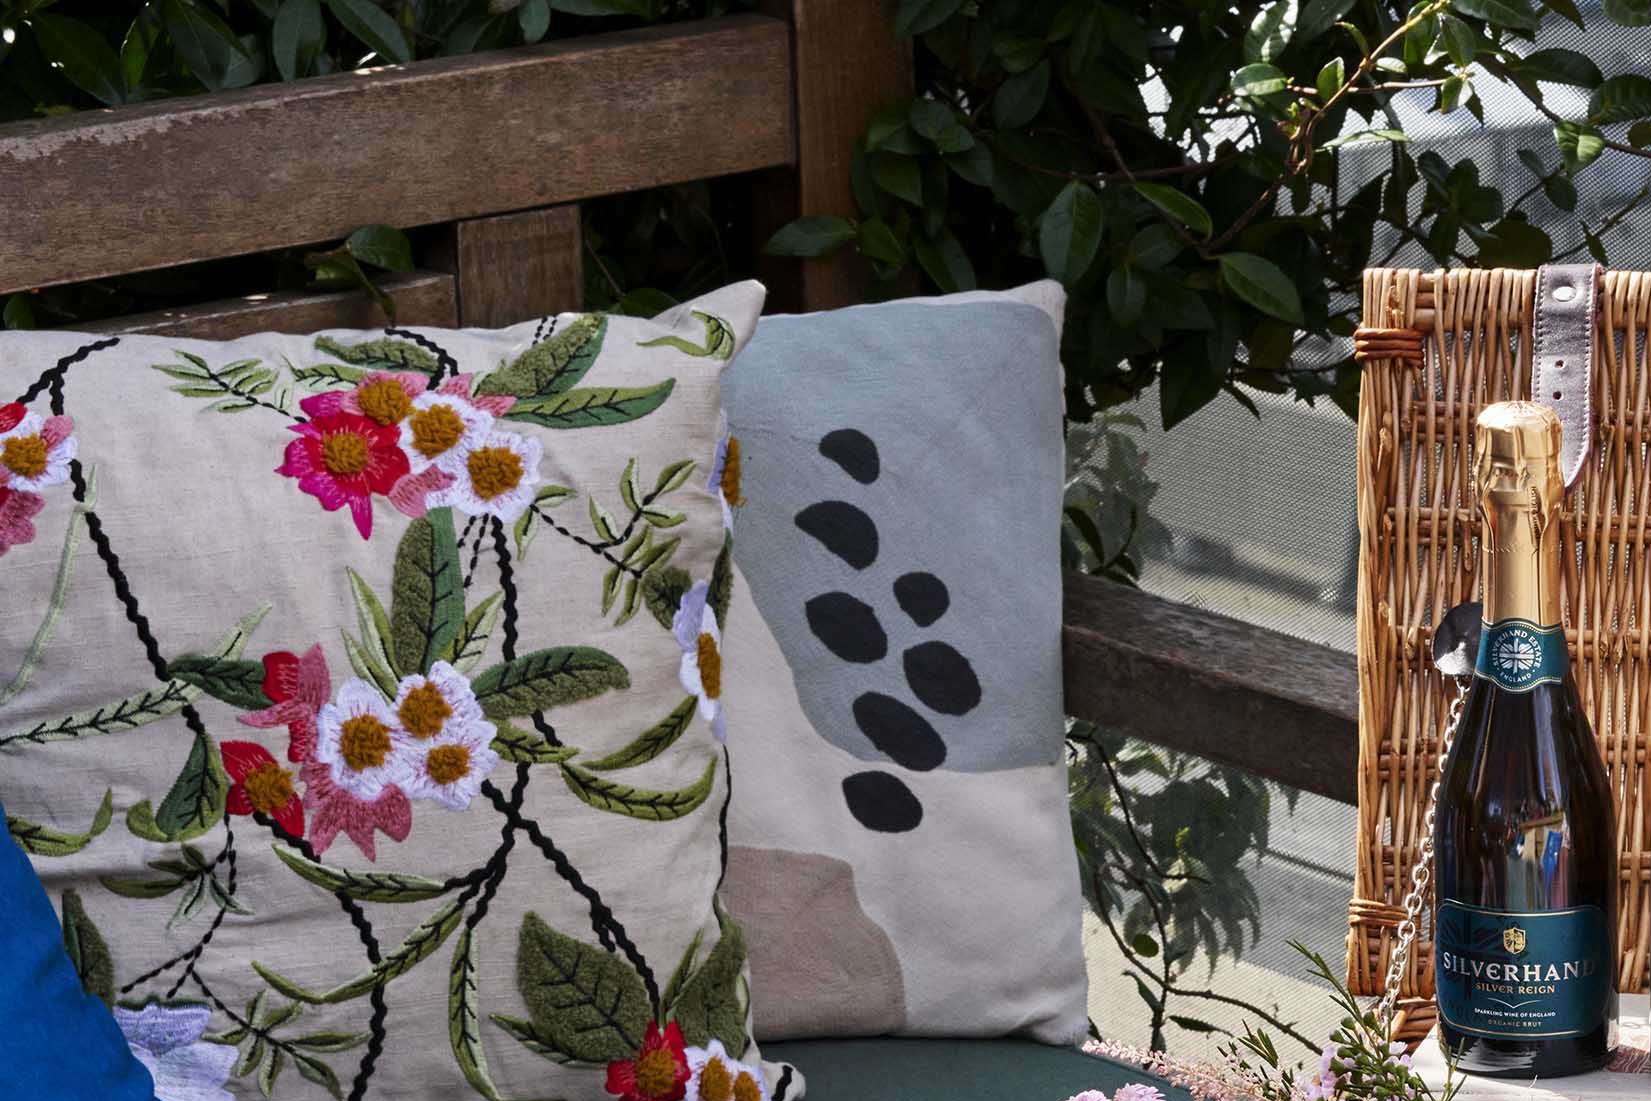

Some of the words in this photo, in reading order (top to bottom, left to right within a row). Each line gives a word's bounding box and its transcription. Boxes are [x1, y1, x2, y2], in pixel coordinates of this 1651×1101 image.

[1528, 636, 1542, 668] ESTATE
[1443, 951, 1596, 983] SILVERHAND
[1475, 982, 1514, 995] SILVER
[1518, 984, 1556, 995] REIGN
[1474, 1007, 1502, 1018] SPARKLING
[1529, 1010, 1556, 1018] ENGLAND
